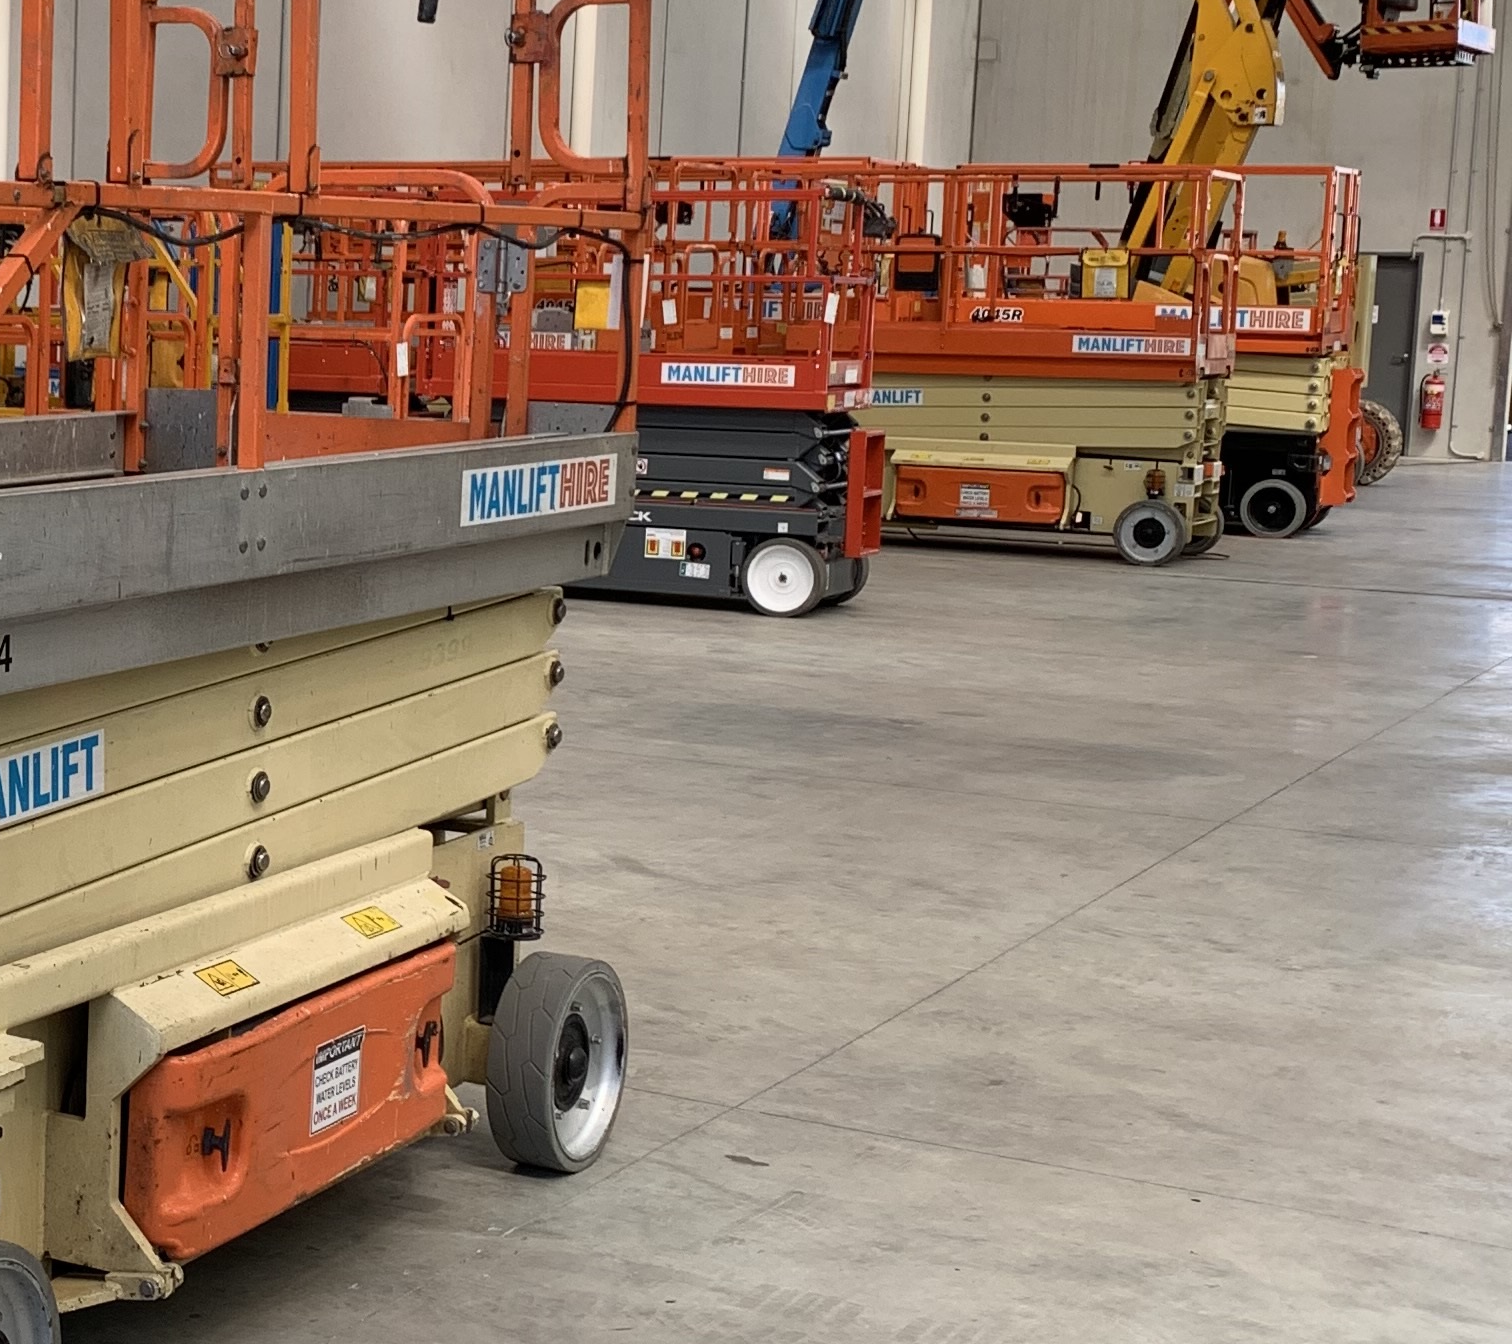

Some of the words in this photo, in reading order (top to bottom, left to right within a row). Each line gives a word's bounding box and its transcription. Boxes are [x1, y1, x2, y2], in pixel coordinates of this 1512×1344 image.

[872, 390, 920, 403] ANLIFT
[315, 1033, 363, 1065] IMPORTANT
[315, 1069, 334, 1088] CHECK
[335, 1059, 358, 1078] BATTERY
[316, 1086, 334, 1104] WATER
[336, 1076, 356, 1095] LEVELS
[314, 1105, 331, 1125] ONCE
[339, 1093, 356, 1113] WEEK
